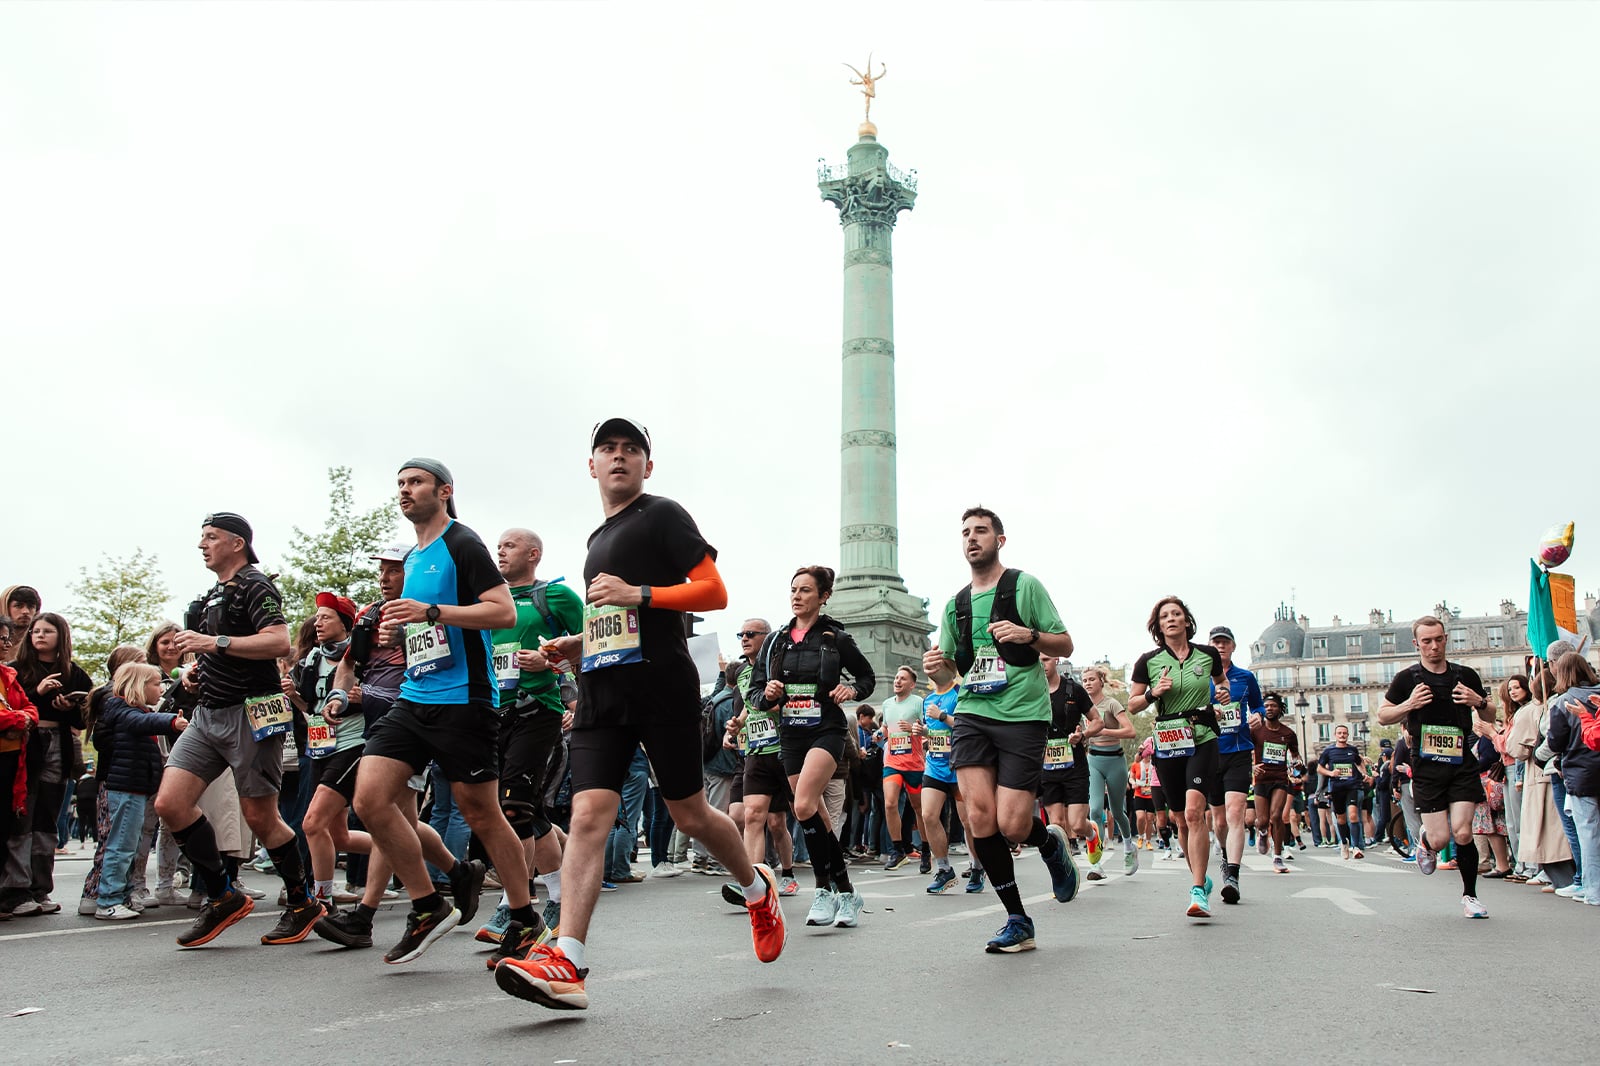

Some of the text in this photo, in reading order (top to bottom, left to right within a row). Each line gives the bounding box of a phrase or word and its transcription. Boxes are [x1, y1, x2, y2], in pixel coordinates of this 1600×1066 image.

[589, 614, 622, 642] 31086
[970, 658, 994, 674] 847
[250, 699, 284, 720] 29168
[750, 720, 769, 734] 27170
[1158, 729, 1184, 743] 38684
[1428, 735, 1454, 749] 11993
